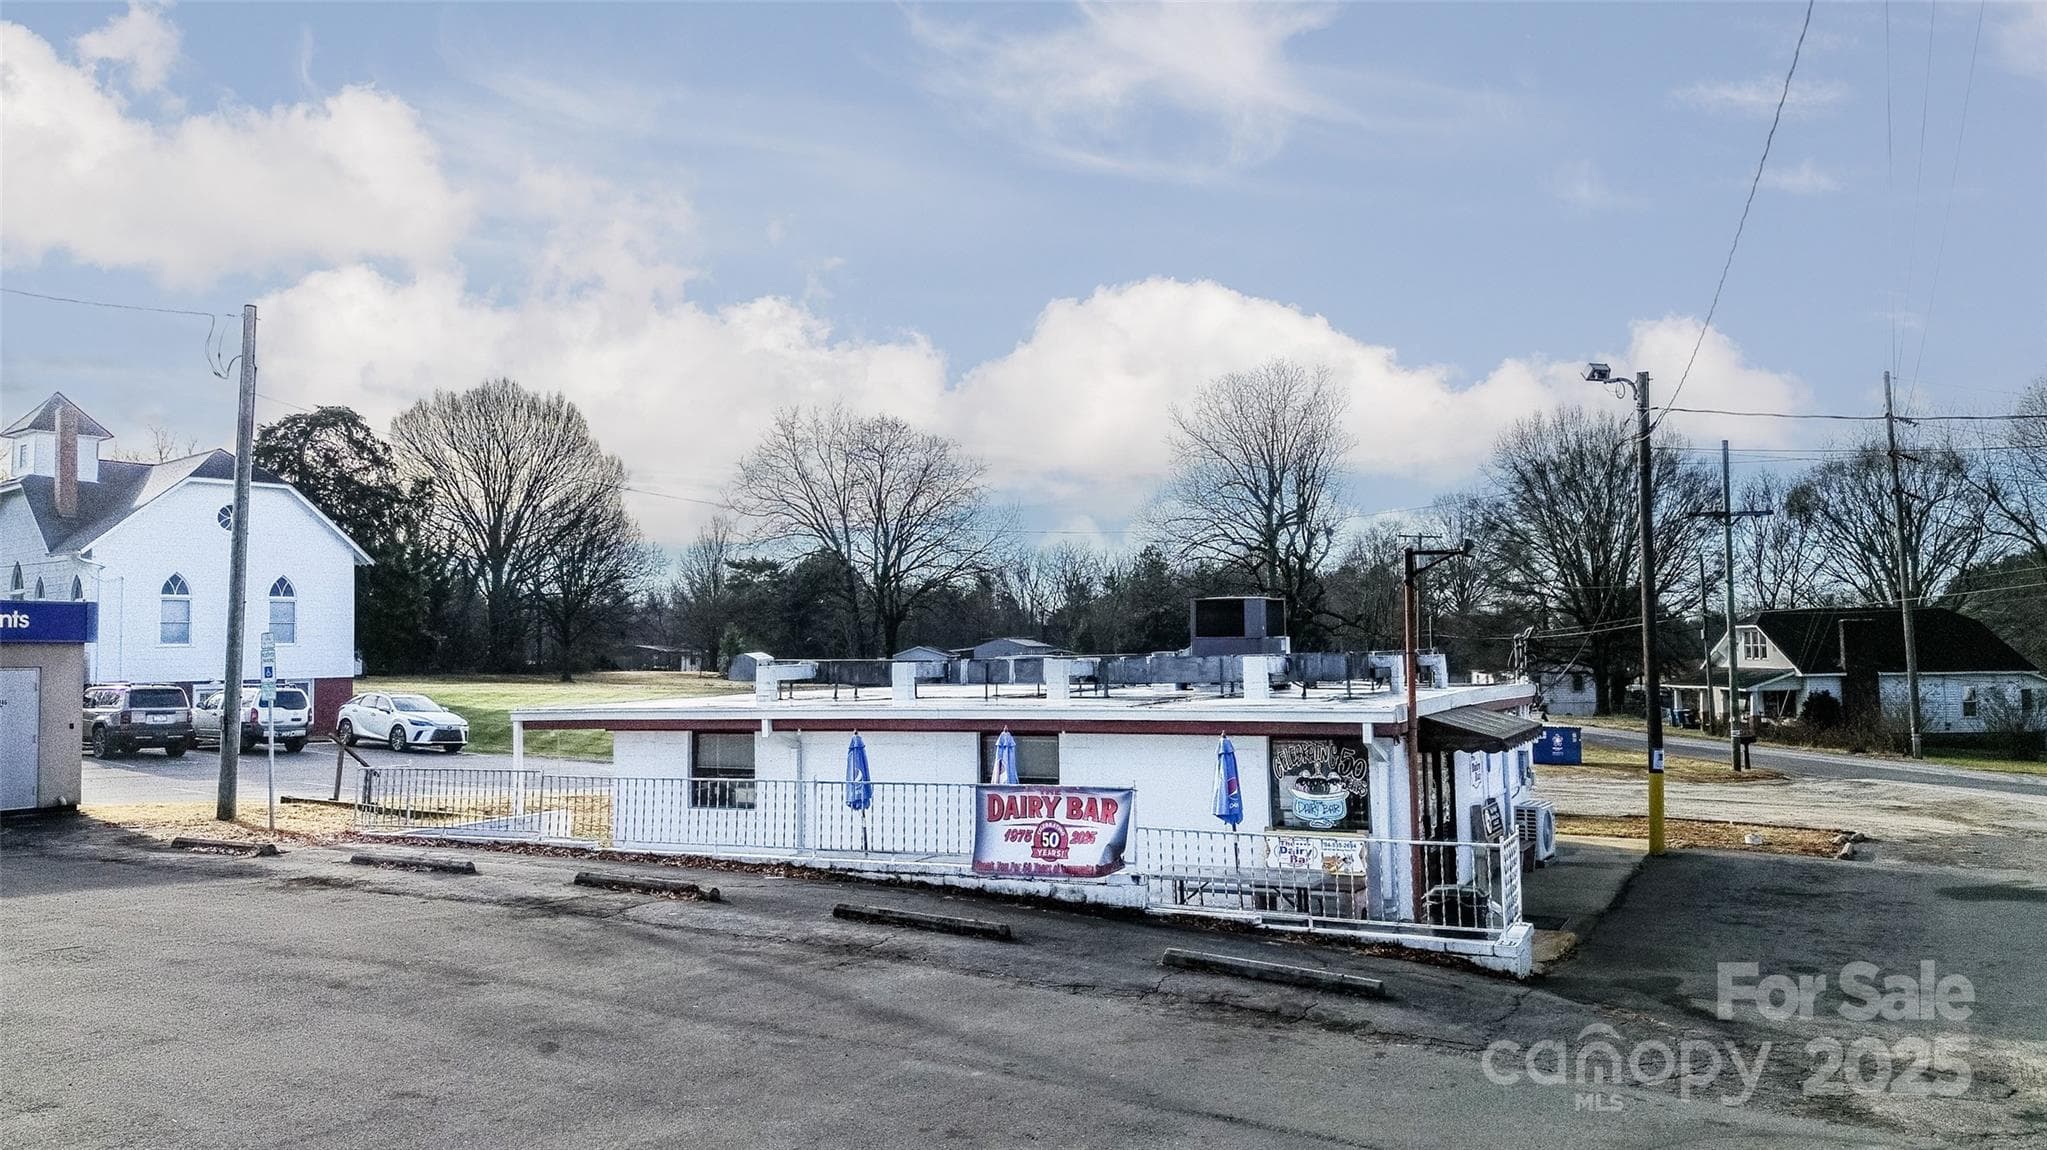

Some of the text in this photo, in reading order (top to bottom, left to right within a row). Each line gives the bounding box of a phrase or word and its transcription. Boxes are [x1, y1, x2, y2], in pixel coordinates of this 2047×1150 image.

[1338, 747, 1368, 781] 50
[987, 793, 1119, 826] DAIRY BAR
[1042, 831, 1061, 848] 50
[1280, 846, 1313, 857] Dairy
